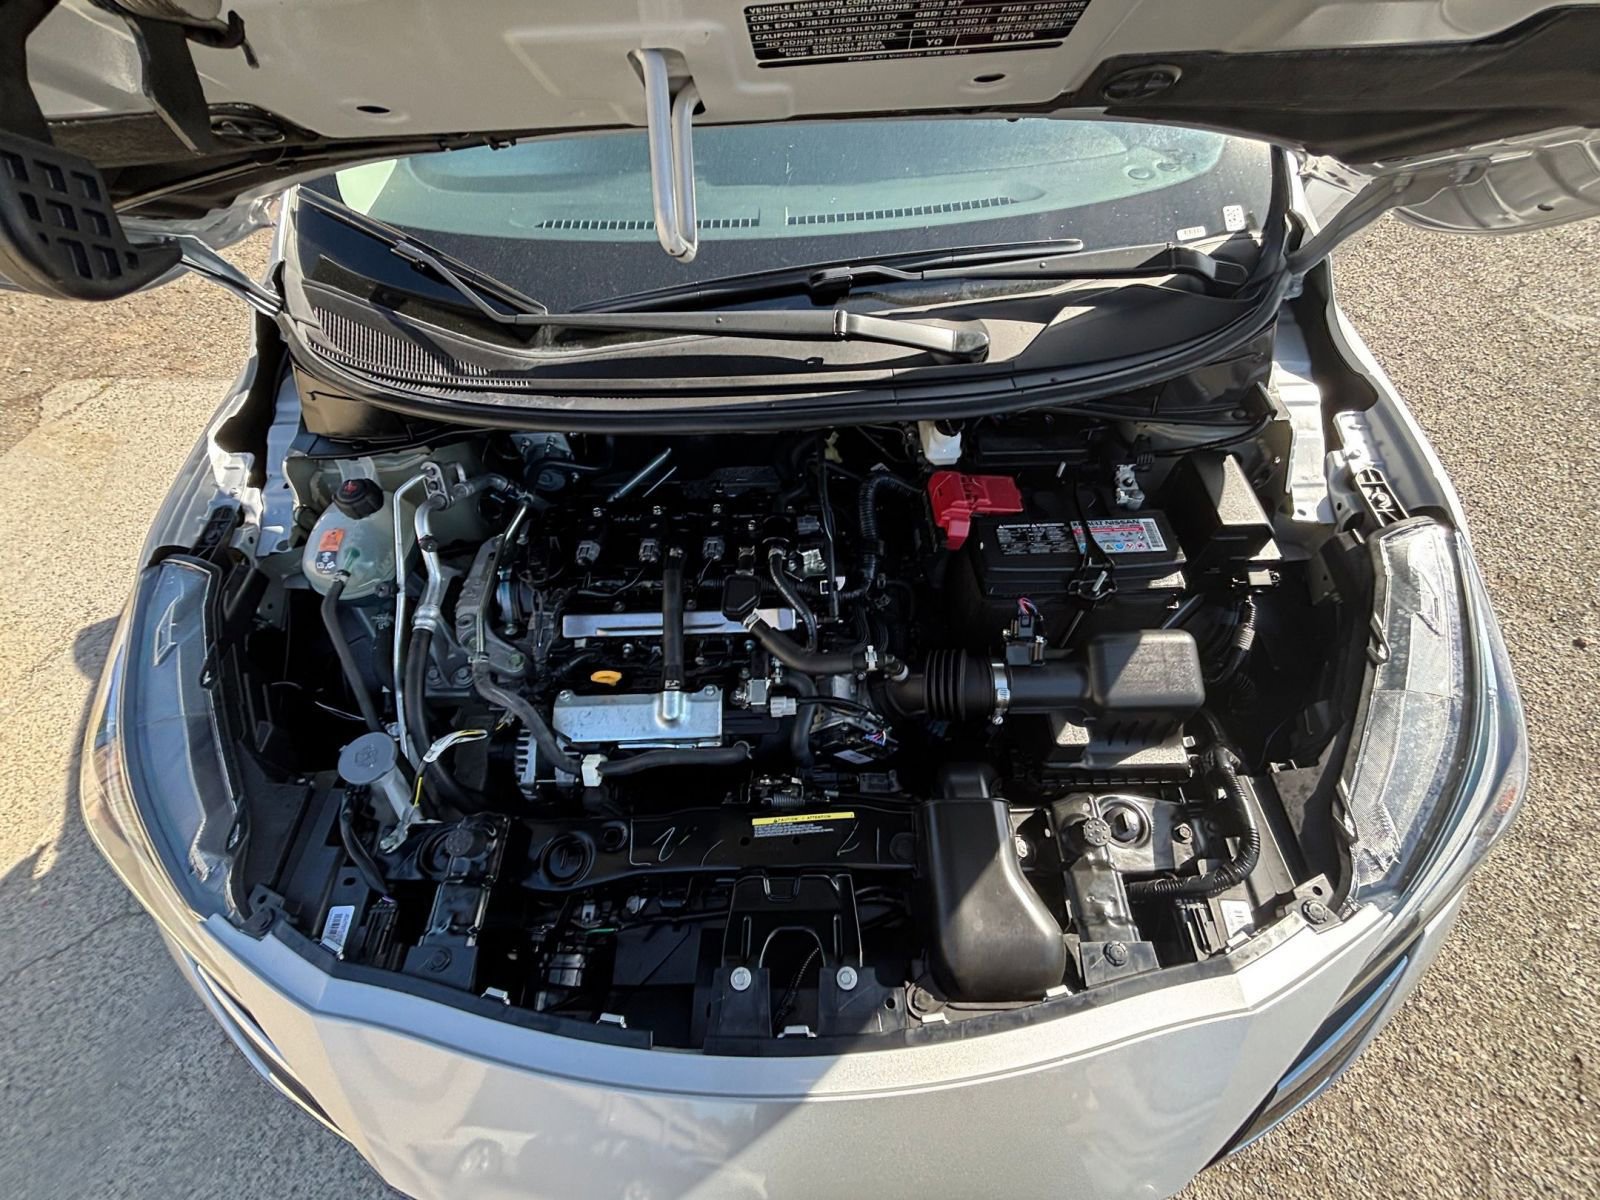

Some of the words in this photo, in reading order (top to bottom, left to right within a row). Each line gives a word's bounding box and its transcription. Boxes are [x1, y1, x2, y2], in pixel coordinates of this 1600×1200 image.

[749, 5, 790, 14] VEHICLE
[793, 0, 843, 10] EMISSION
[750, 11, 813, 22] CONFORMS
[833, 3, 913, 14] REGULATIONS:
[752, 23, 772, 31] U.S.
[774, 21, 798, 29] EPA:
[879, 13, 898, 21] LDV
[1033, 0, 1087, 11] GASOLINE
[755, 29, 817, 41] CALIFORNIA:
[956, 18, 979, 26] OBD
[1028, 11, 1081, 21] GASOLINE
[783, 35, 853, 46] ADJUSTMENTS
[855, 31, 896, 40] NEEDED
